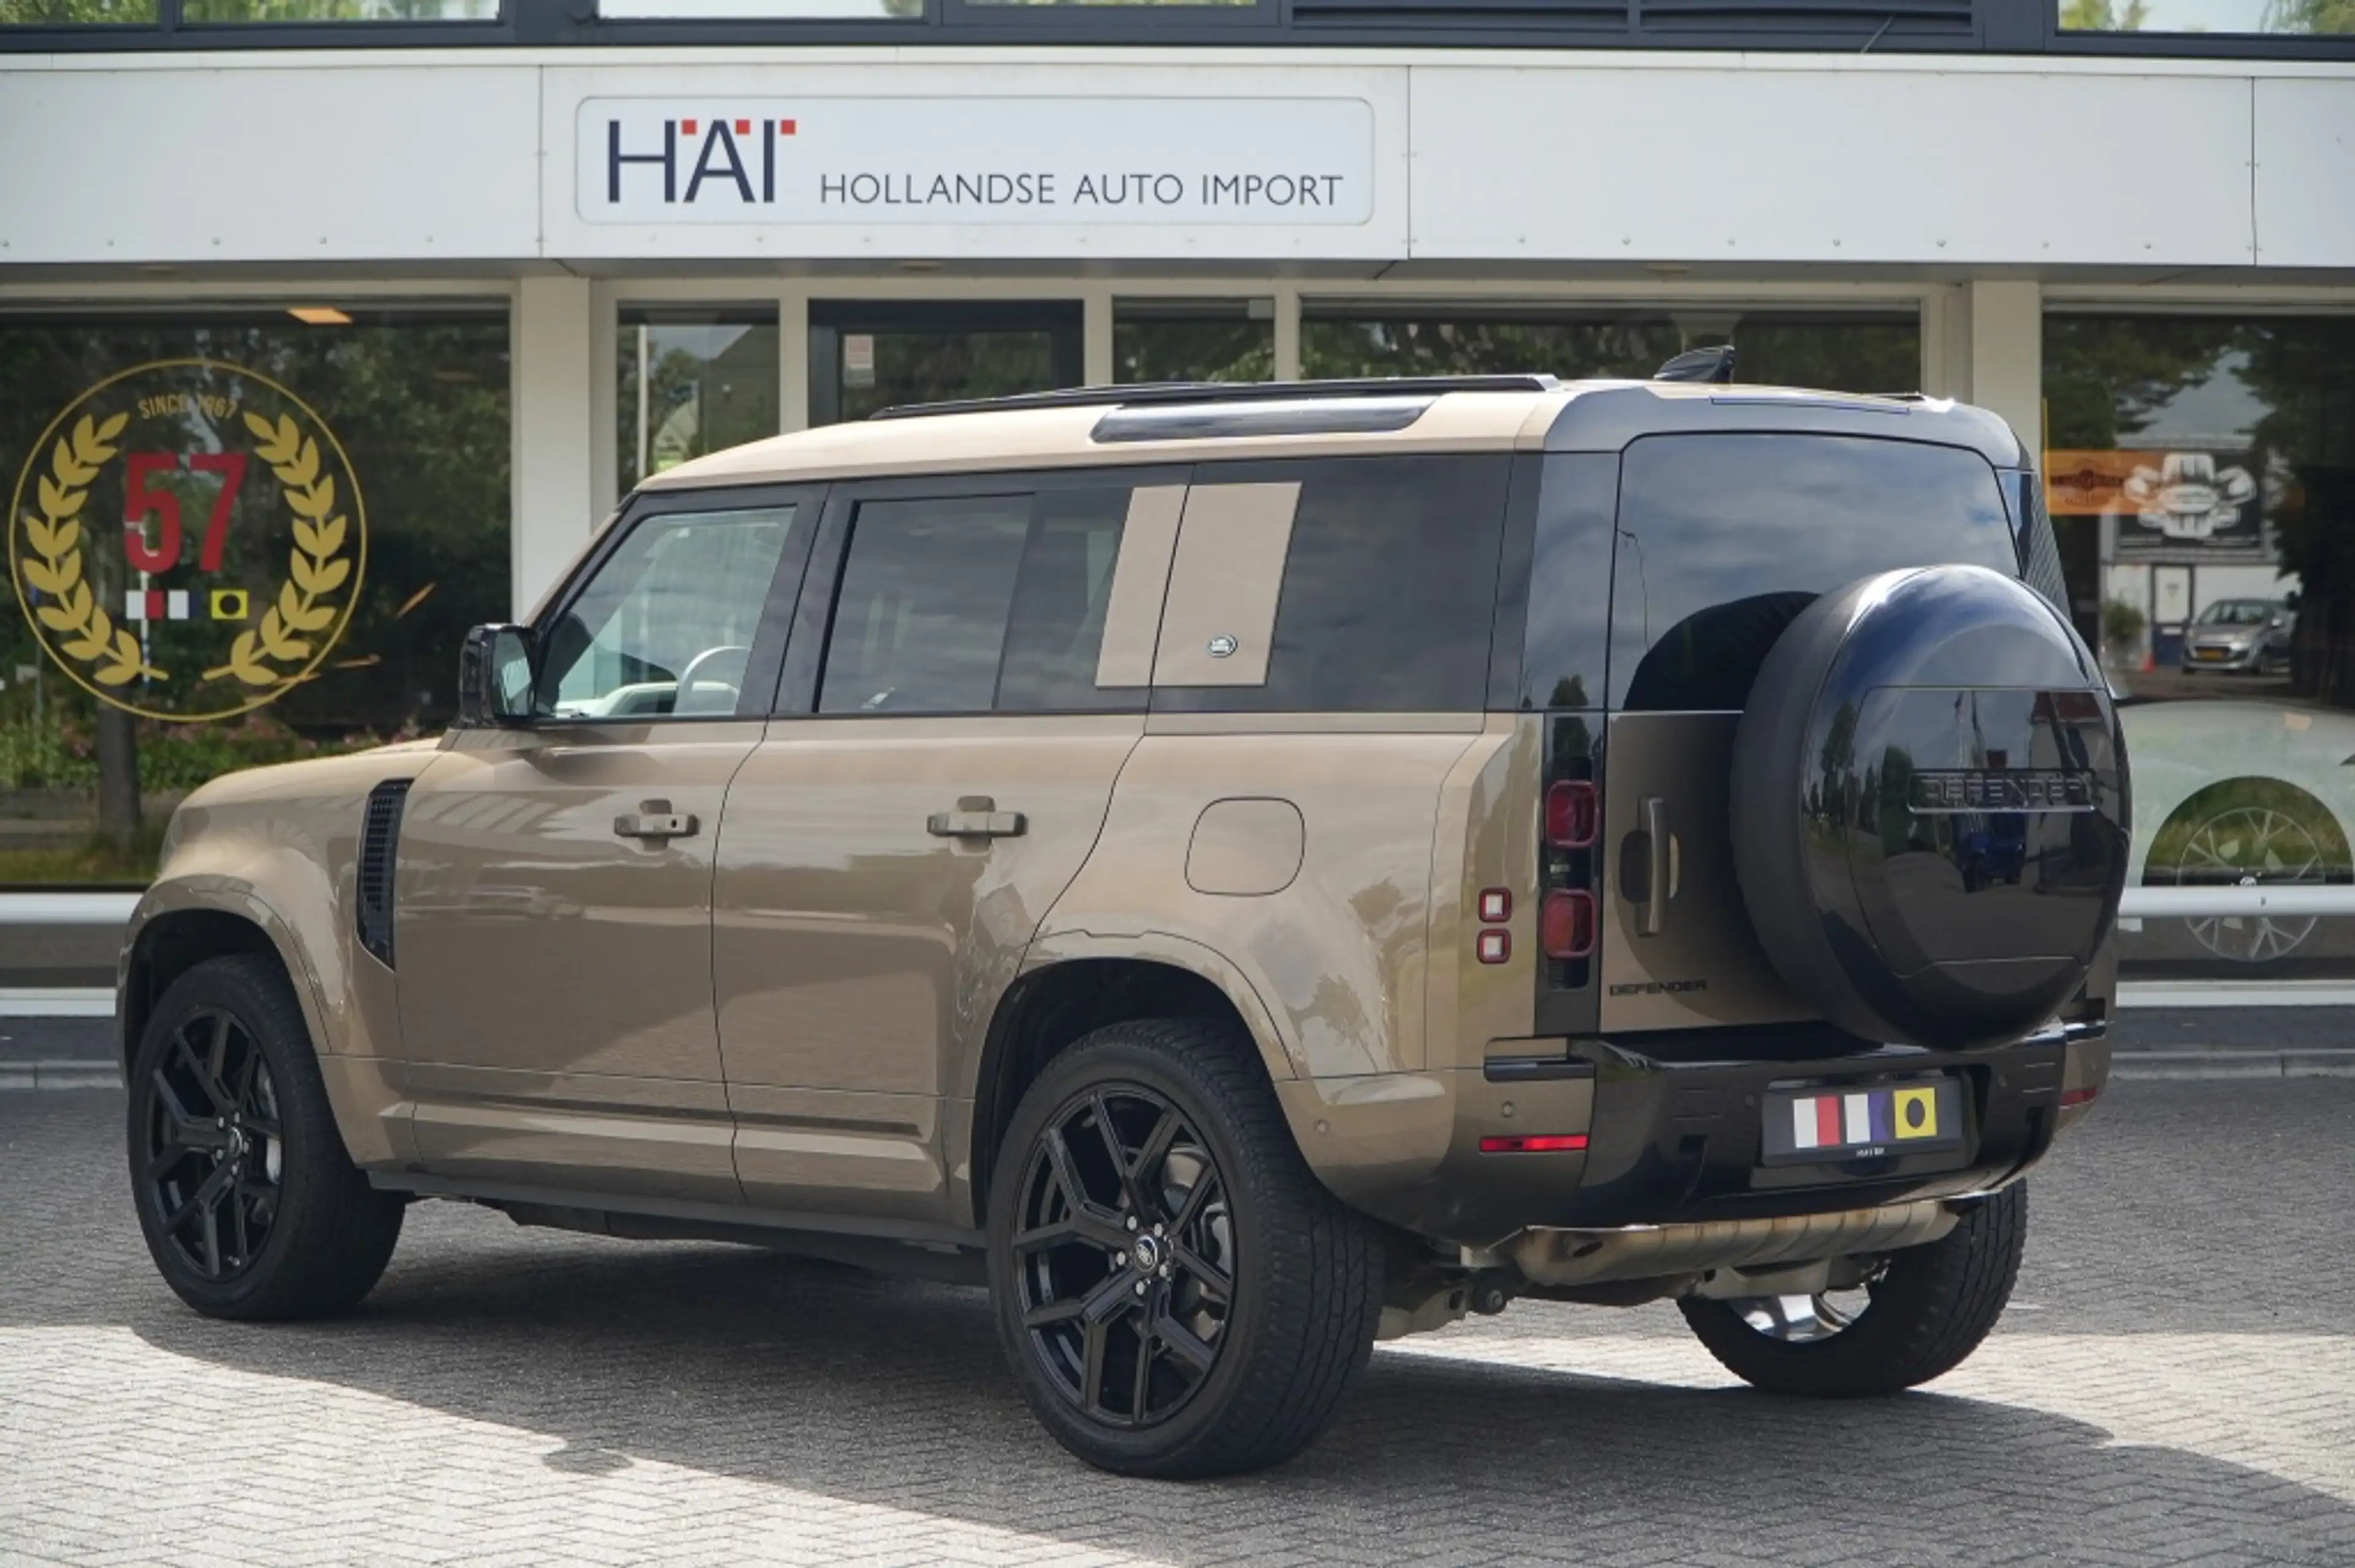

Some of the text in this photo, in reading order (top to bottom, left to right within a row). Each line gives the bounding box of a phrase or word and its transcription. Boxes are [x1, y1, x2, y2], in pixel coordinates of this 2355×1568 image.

[608, 120, 796, 203] HAI
[821, 173, 1344, 205] HOLLANDSE AUTO IMPORT
[138, 393, 189, 419] SINCE
[124, 452, 247, 574] 57
[1609, 981, 1707, 996] DEFENDER
